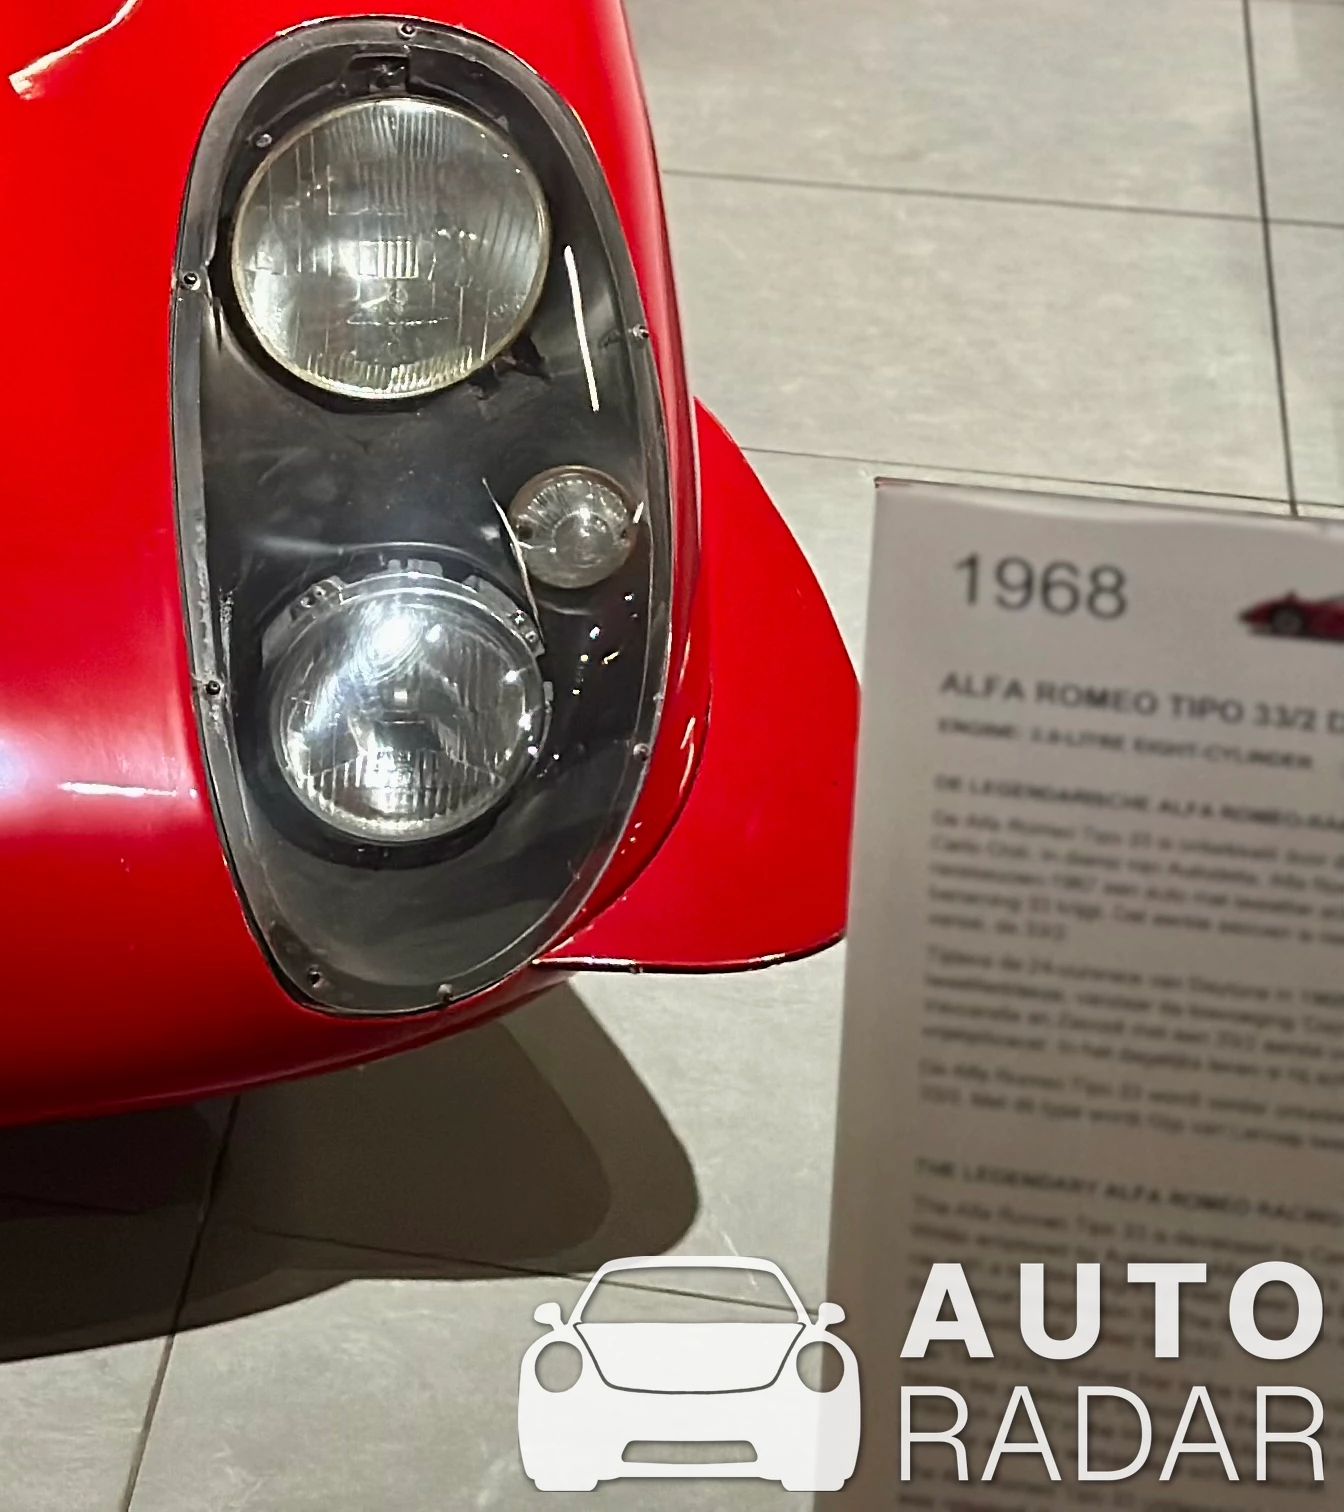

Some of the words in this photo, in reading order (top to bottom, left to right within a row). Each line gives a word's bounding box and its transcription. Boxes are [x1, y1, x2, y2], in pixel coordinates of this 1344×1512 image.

[953, 552, 1129, 621] 1968
[940, 671, 1026, 703] ALFA
[1035, 679, 1159, 716] ROMEO
[1171, 692, 1245, 726] TIPO
[1254, 701, 1317, 733] 33/2
